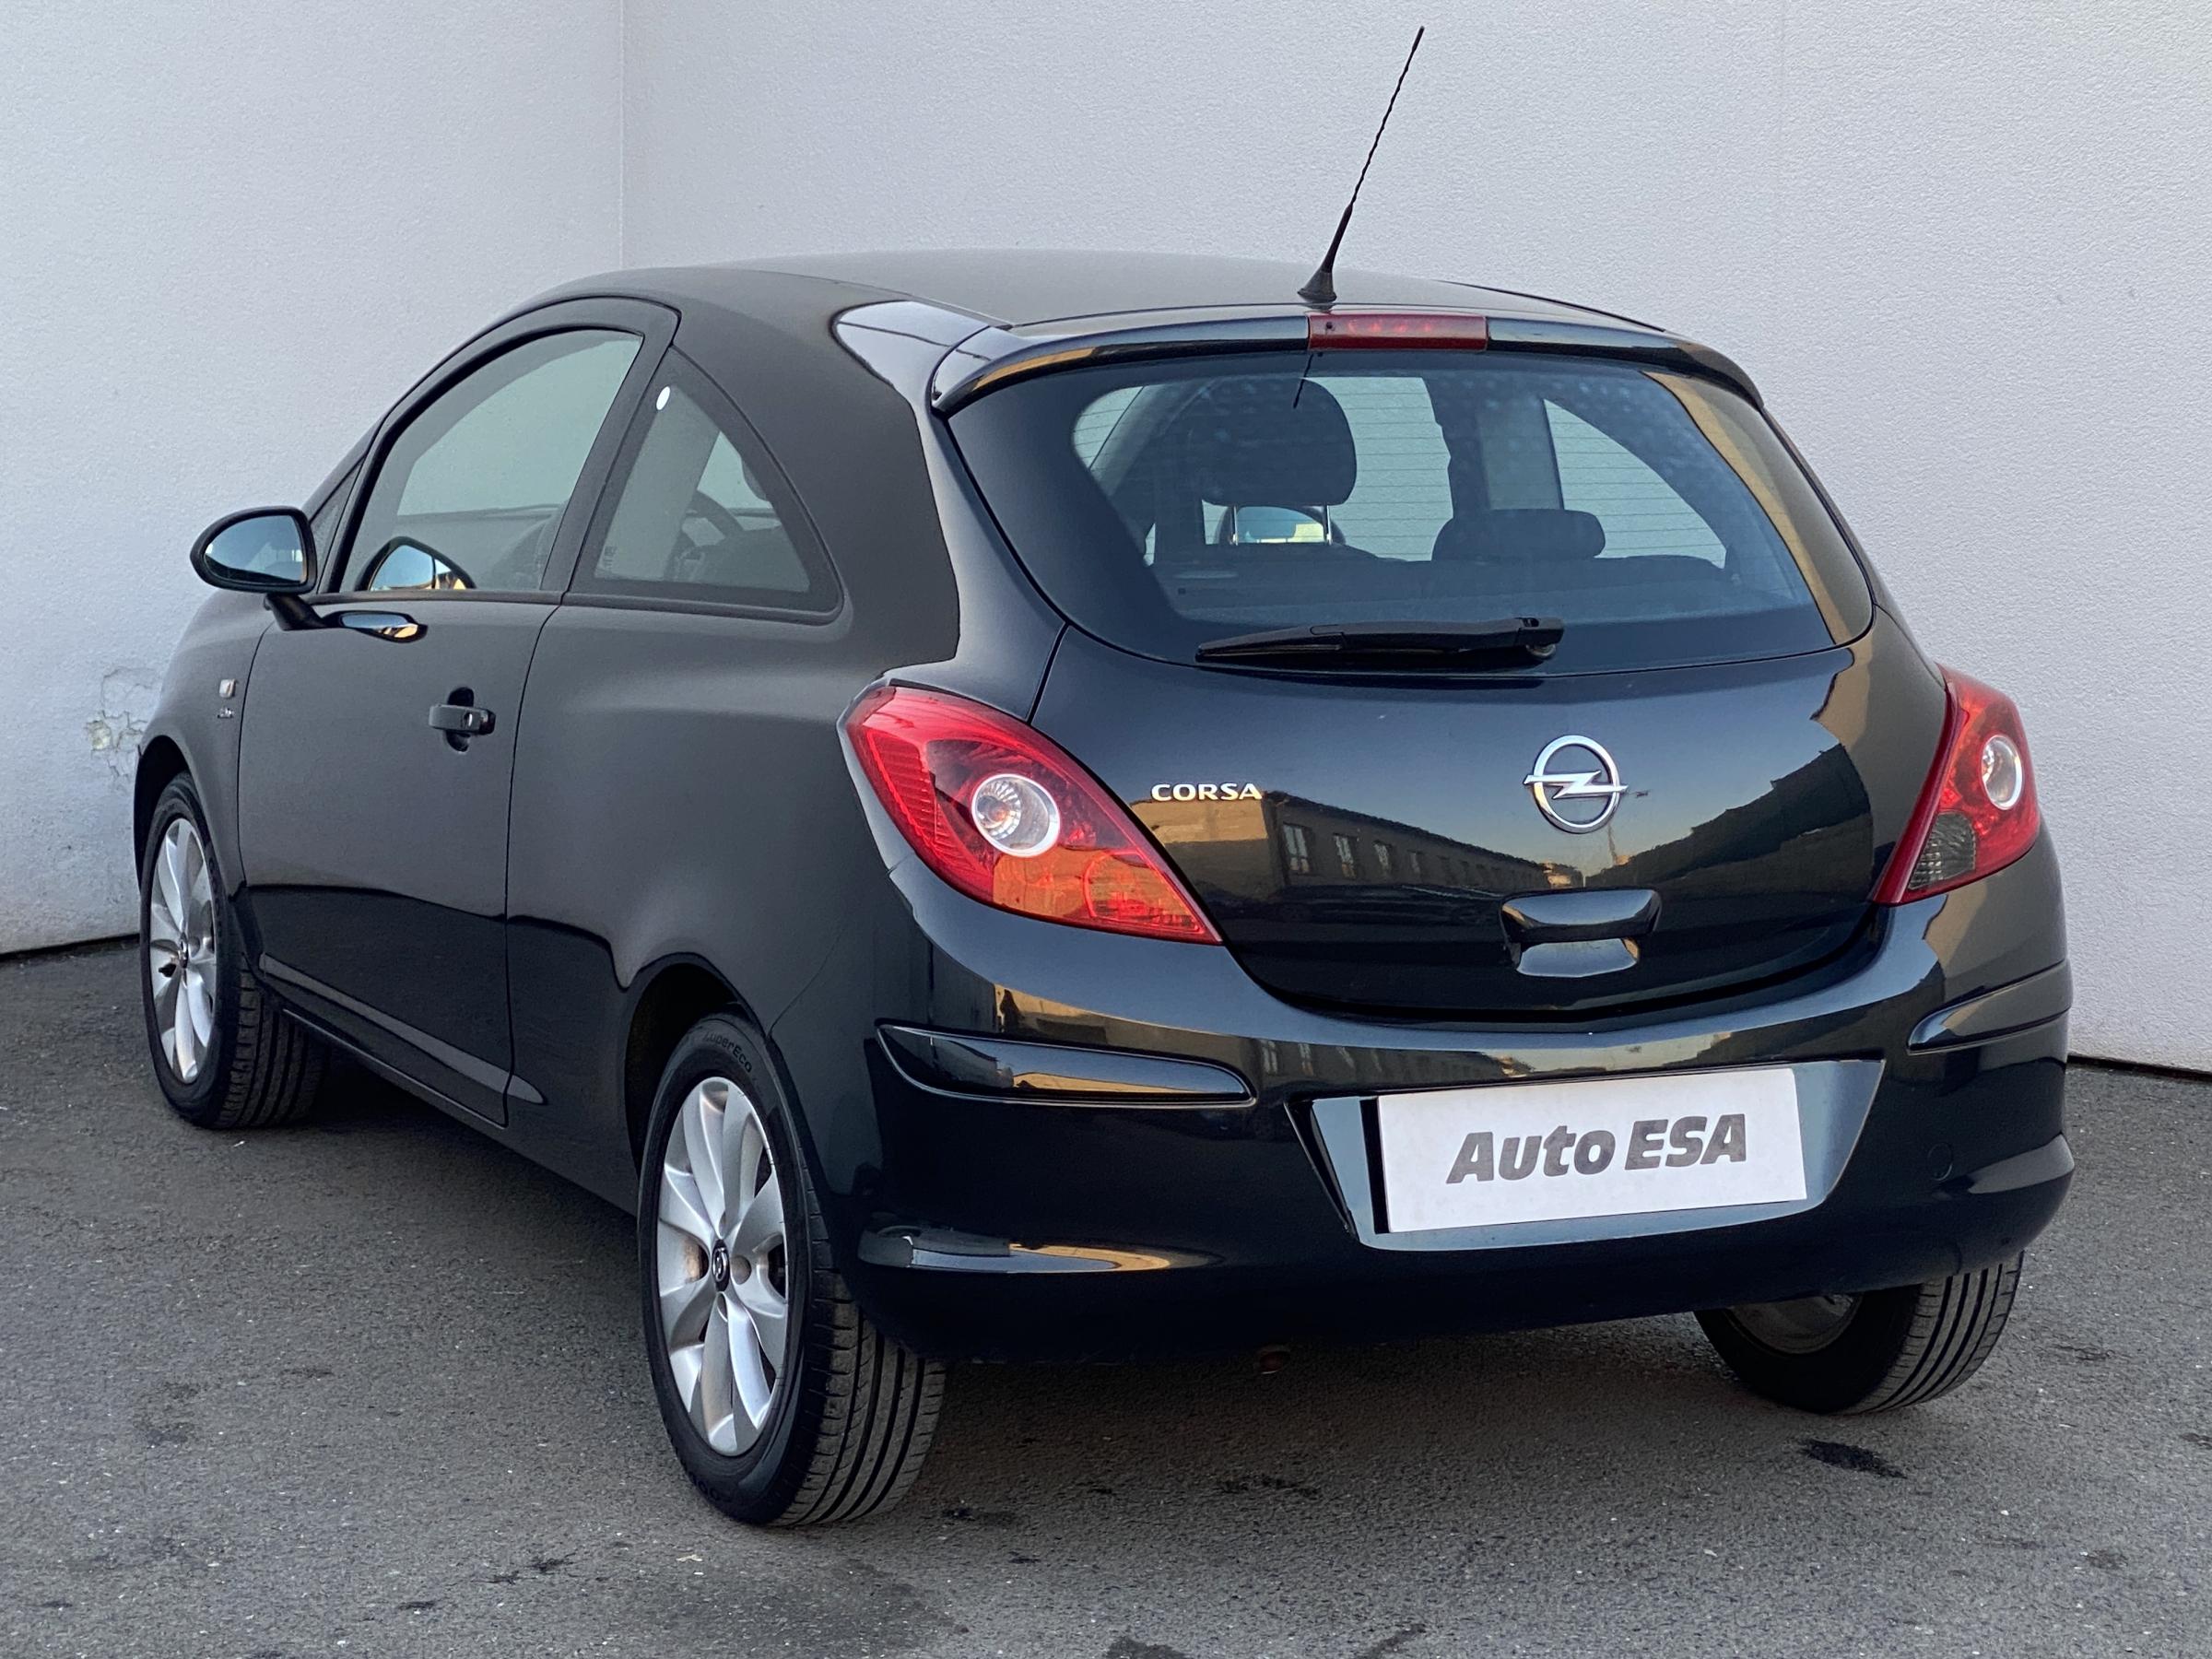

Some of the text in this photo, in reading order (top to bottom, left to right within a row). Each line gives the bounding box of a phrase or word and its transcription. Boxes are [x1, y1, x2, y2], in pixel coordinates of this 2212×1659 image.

[1151, 782, 1263, 801] CORSA
[1445, 1113, 1747, 1184] Auto ESA
